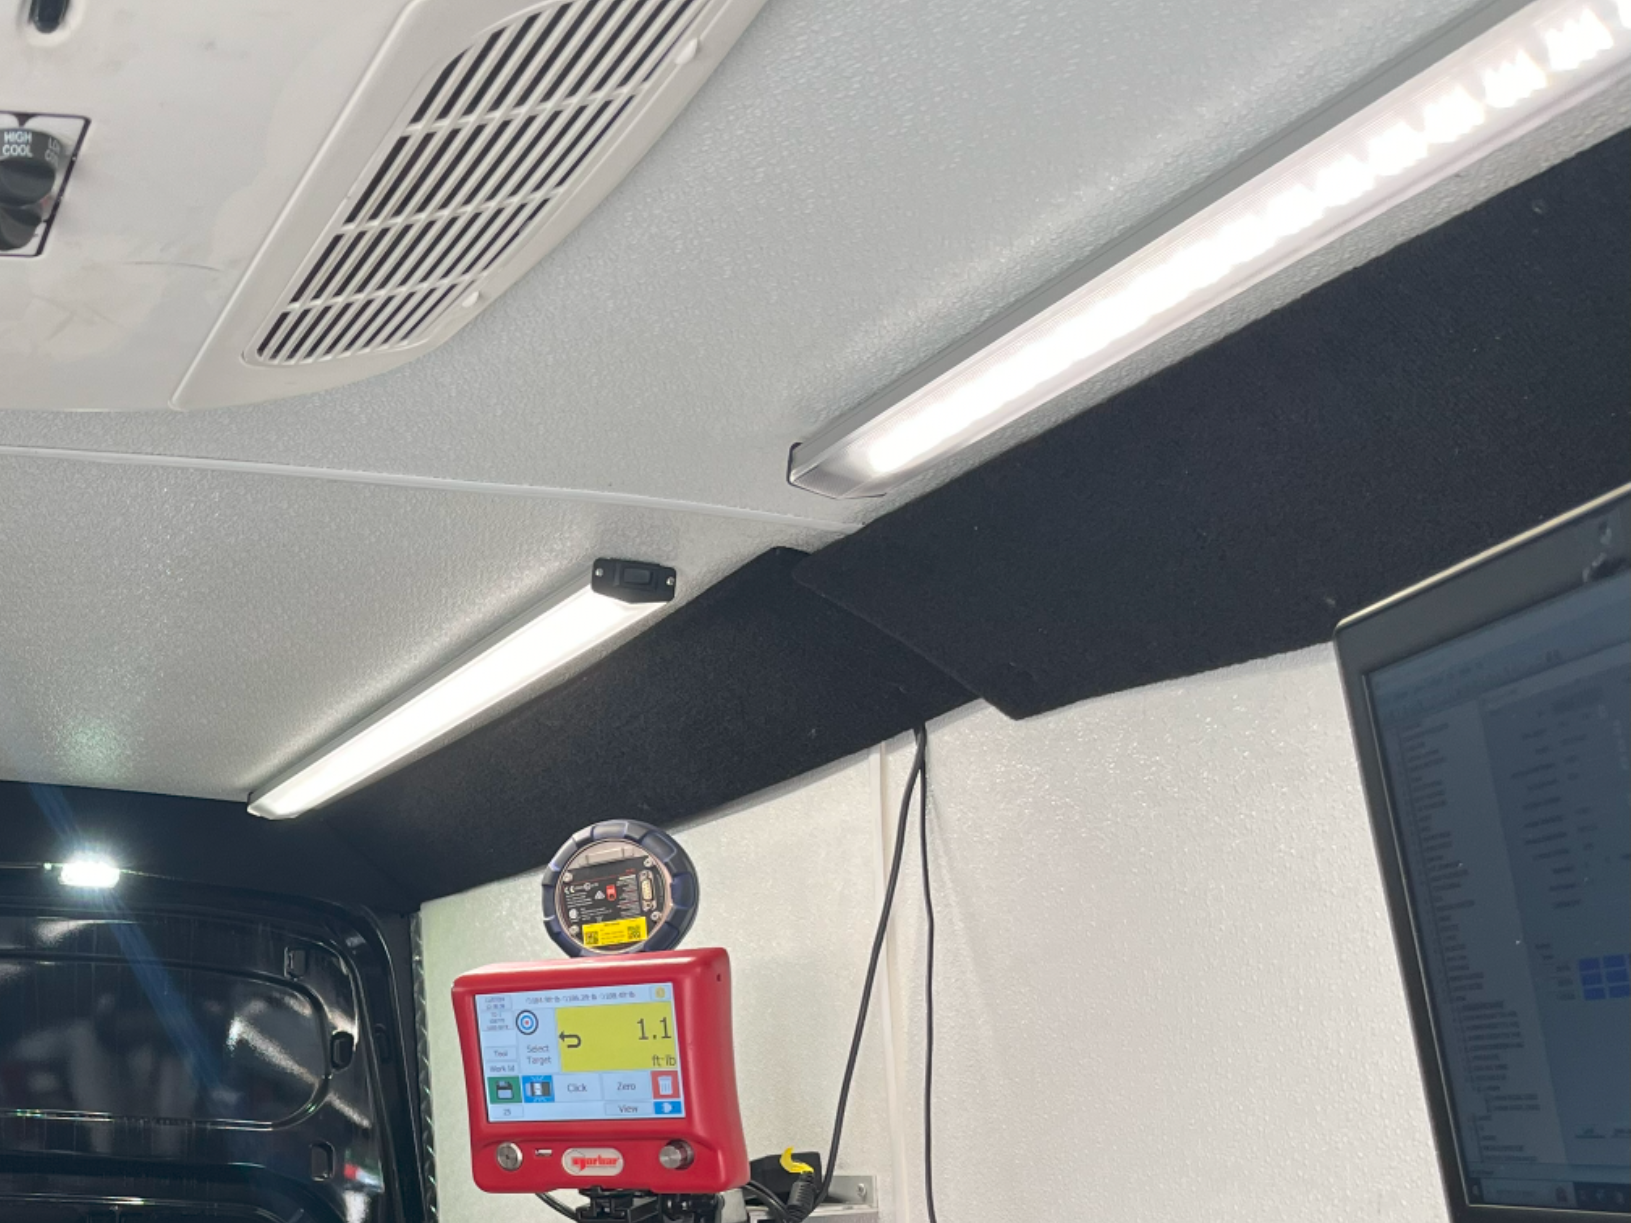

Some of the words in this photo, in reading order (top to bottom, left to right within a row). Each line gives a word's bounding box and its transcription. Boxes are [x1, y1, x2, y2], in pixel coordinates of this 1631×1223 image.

[4, 131, 32, 144] HIGH
[2, 144, 33, 158] COOL
[636, 1016, 672, 1041] 1.1
[527, 1055, 552, 1066] Target
[567, 1083, 588, 1093] Click
[616, 1081, 636, 1091] Zero
[618, 1104, 639, 1113] View
